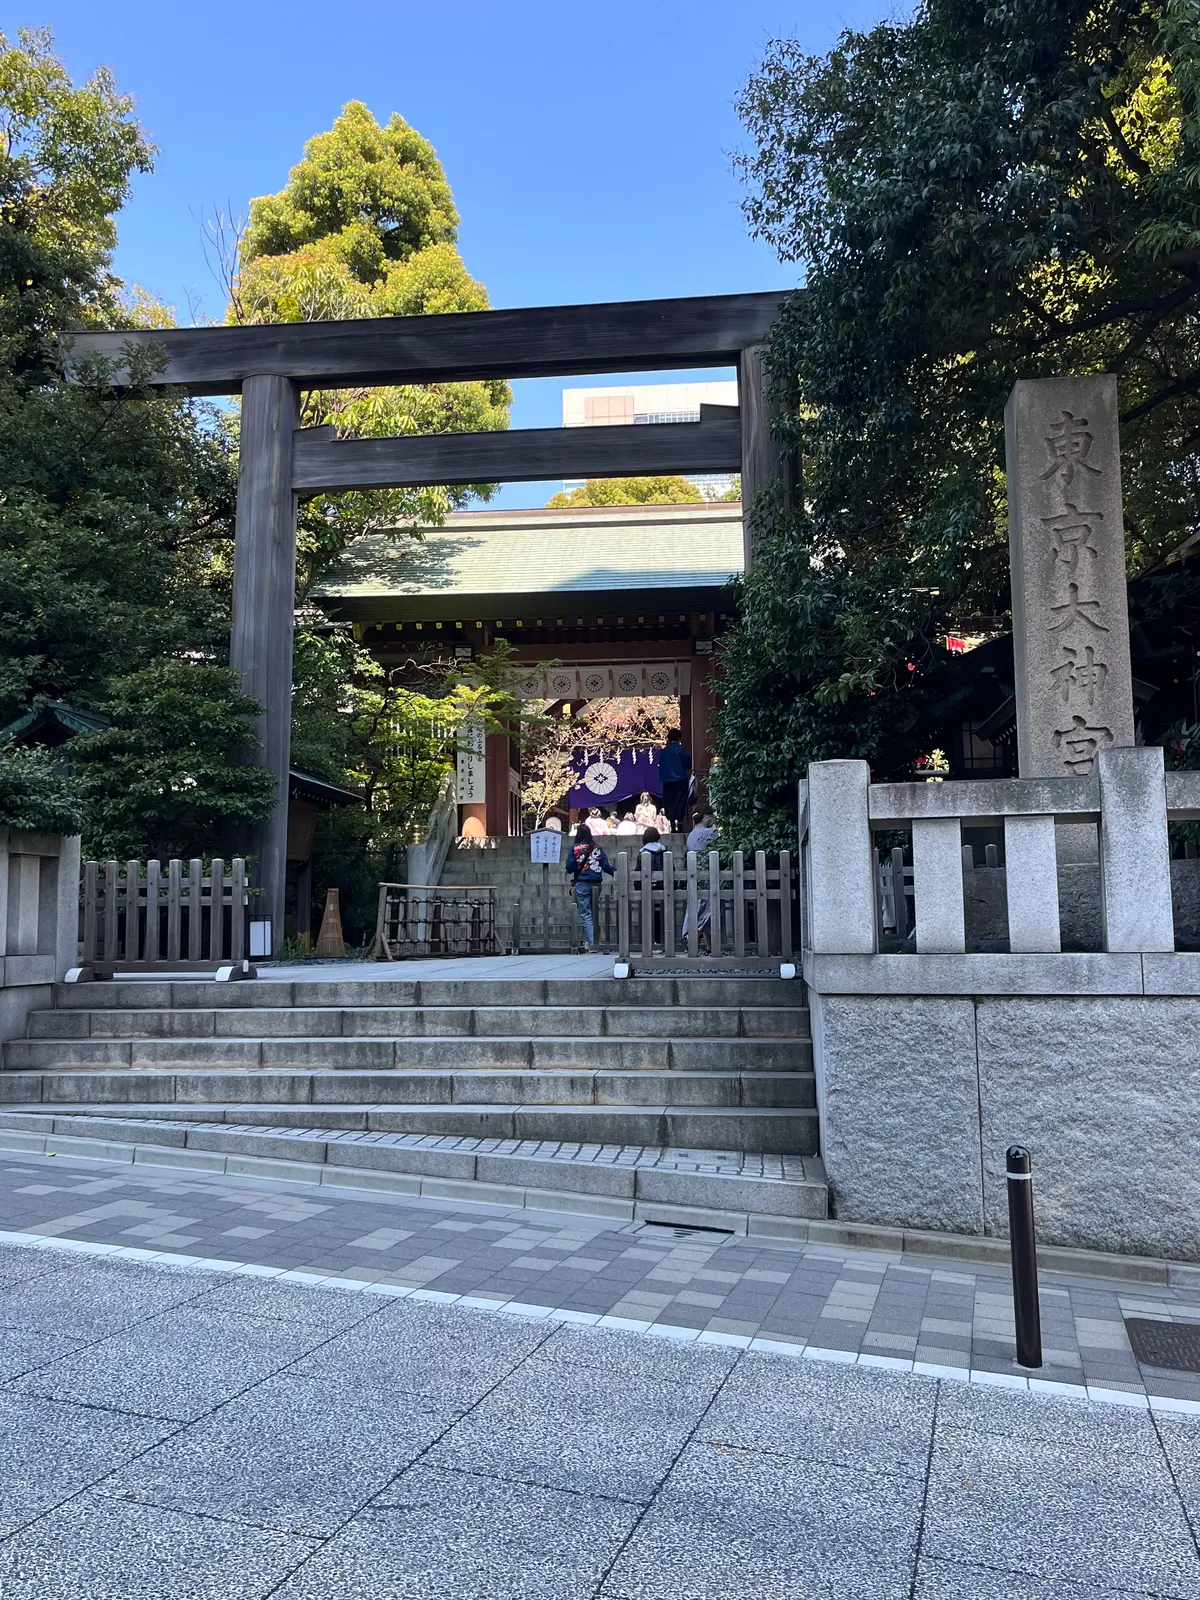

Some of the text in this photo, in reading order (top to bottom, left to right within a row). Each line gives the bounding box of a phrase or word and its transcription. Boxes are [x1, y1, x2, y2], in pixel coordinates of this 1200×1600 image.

[1039, 410, 1114, 777] 東京大神宮
